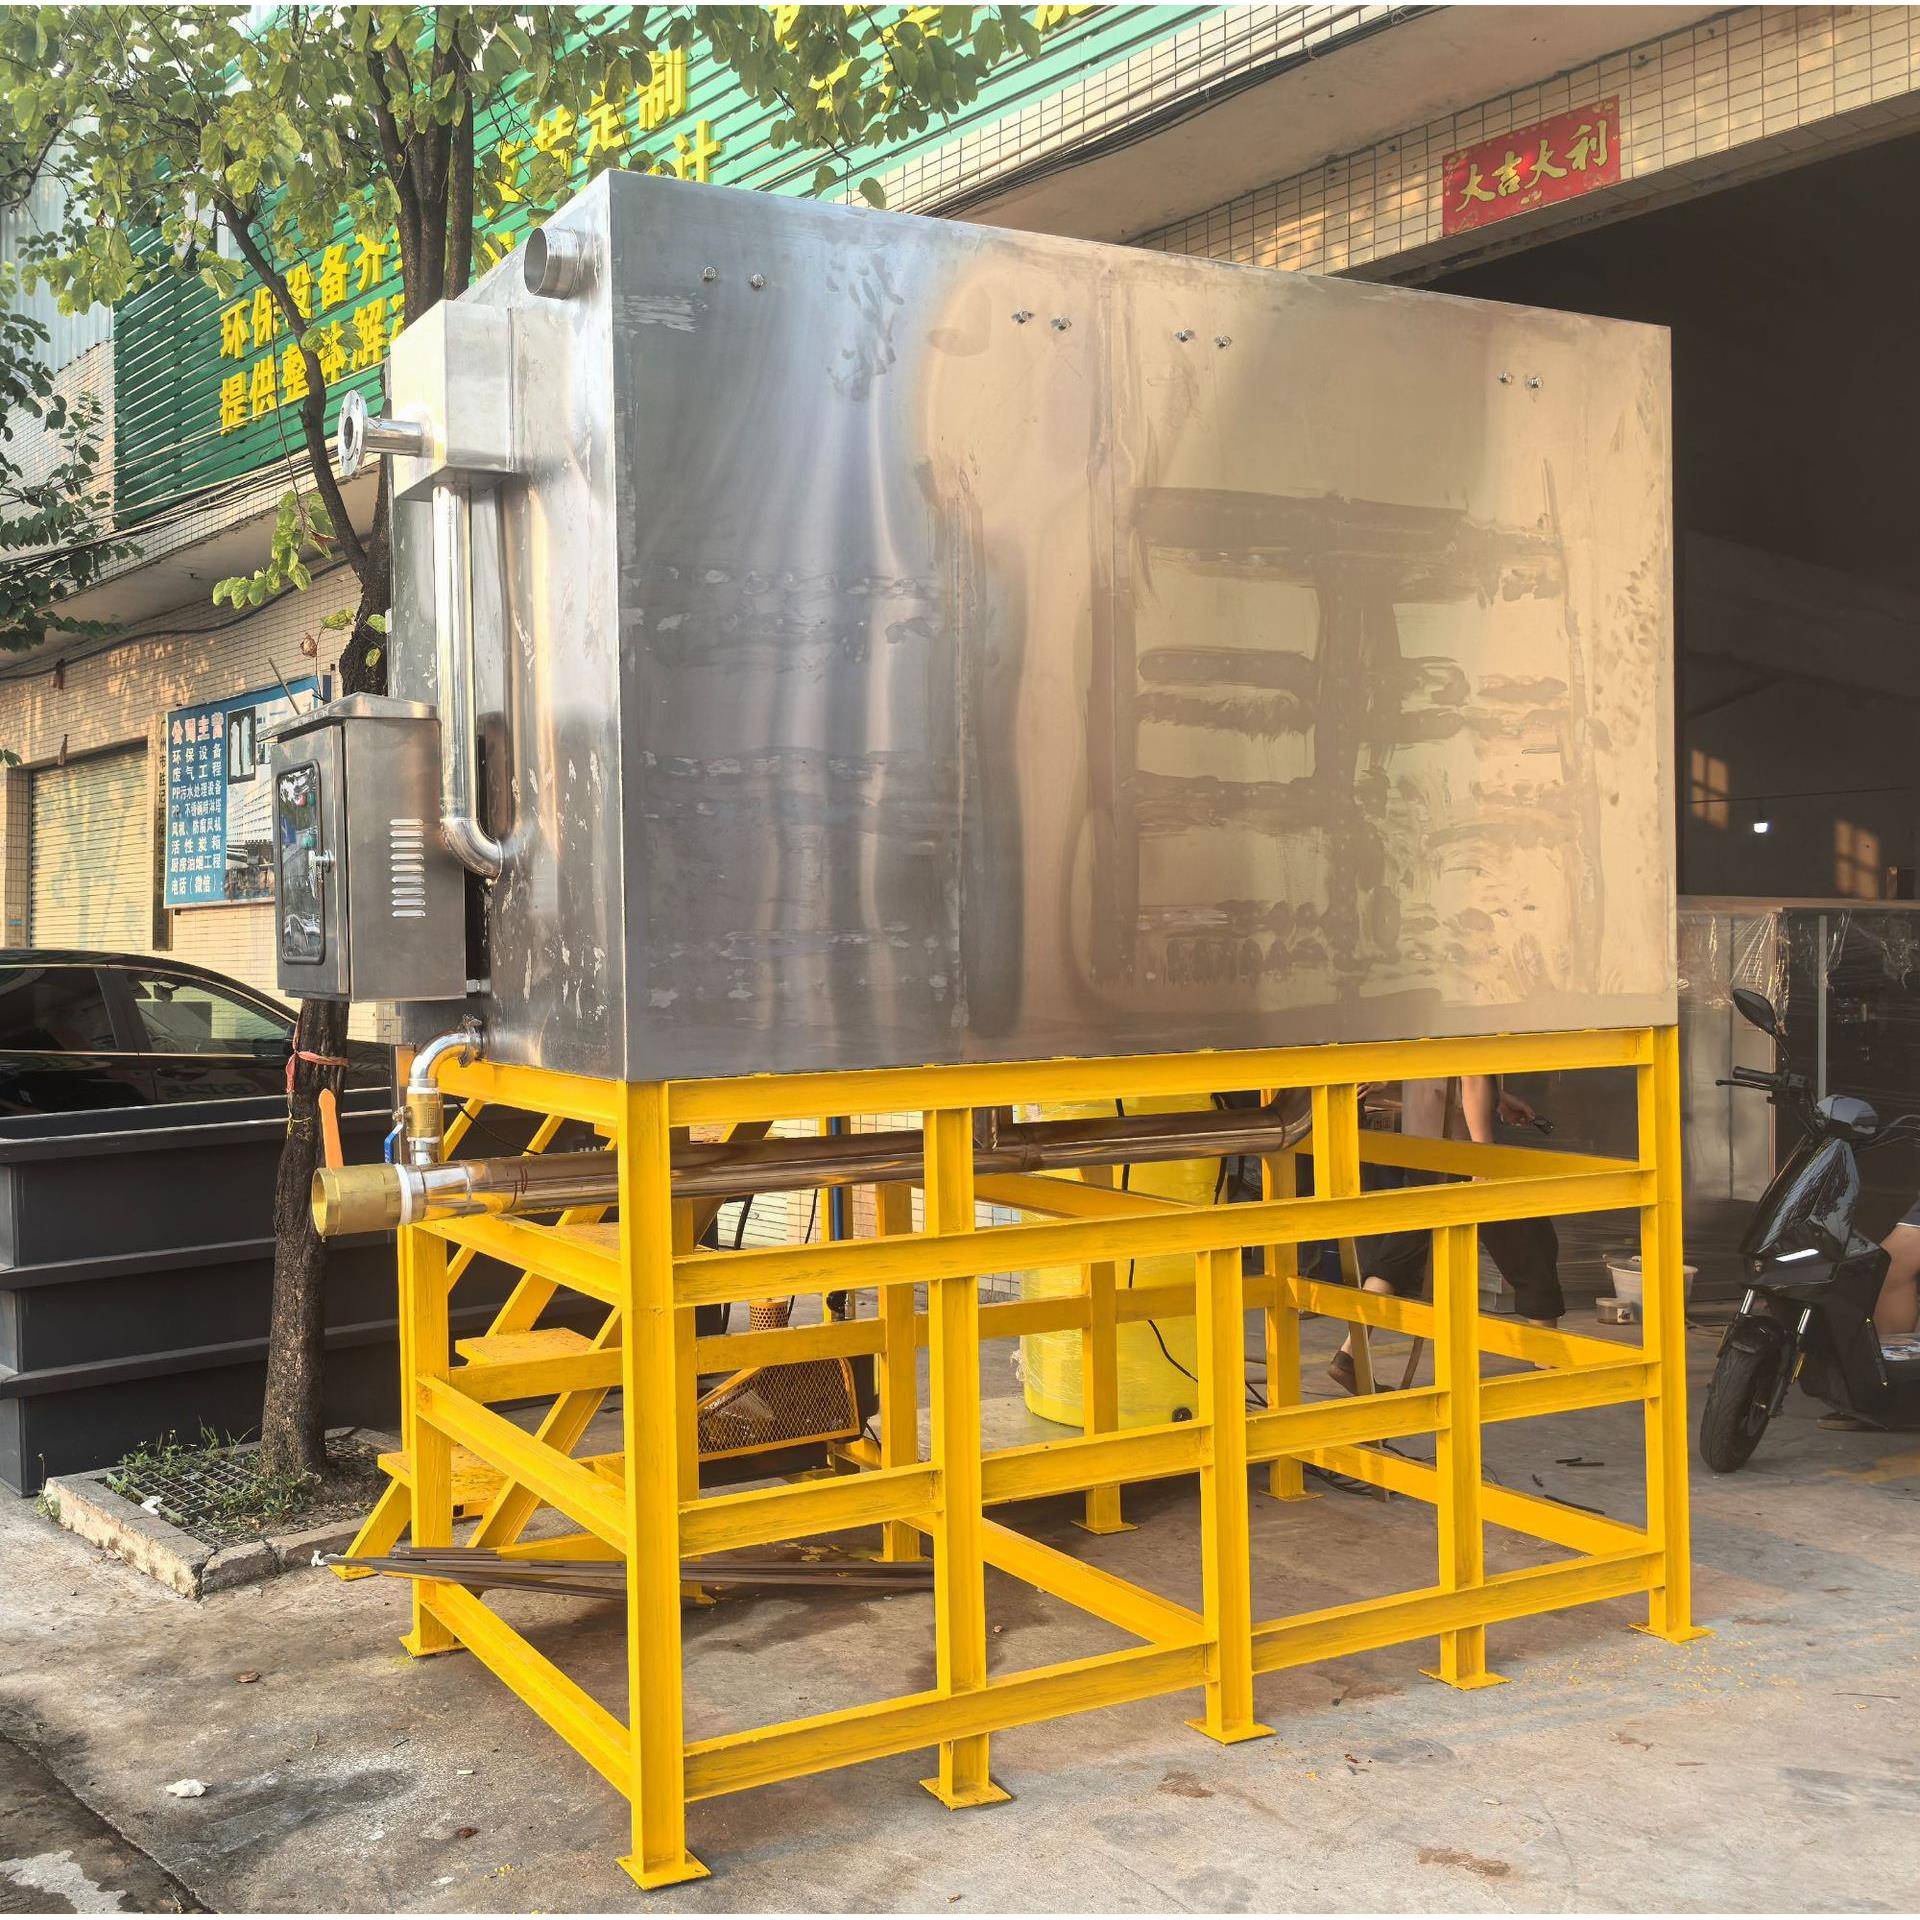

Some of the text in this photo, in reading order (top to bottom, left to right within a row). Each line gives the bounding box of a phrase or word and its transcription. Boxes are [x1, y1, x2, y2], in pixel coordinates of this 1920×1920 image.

[1455, 119, 1609, 213] 大吉大利
[220, 228, 404, 359] 环保设备齐
[220, 291, 405, 437] 提供整体解
[172, 711, 224, 745] 公司主营
[172, 743, 222, 765] 环保设备
[172, 761, 222, 783] 废气工程
[171, 835, 221, 855] 活性炭箱
